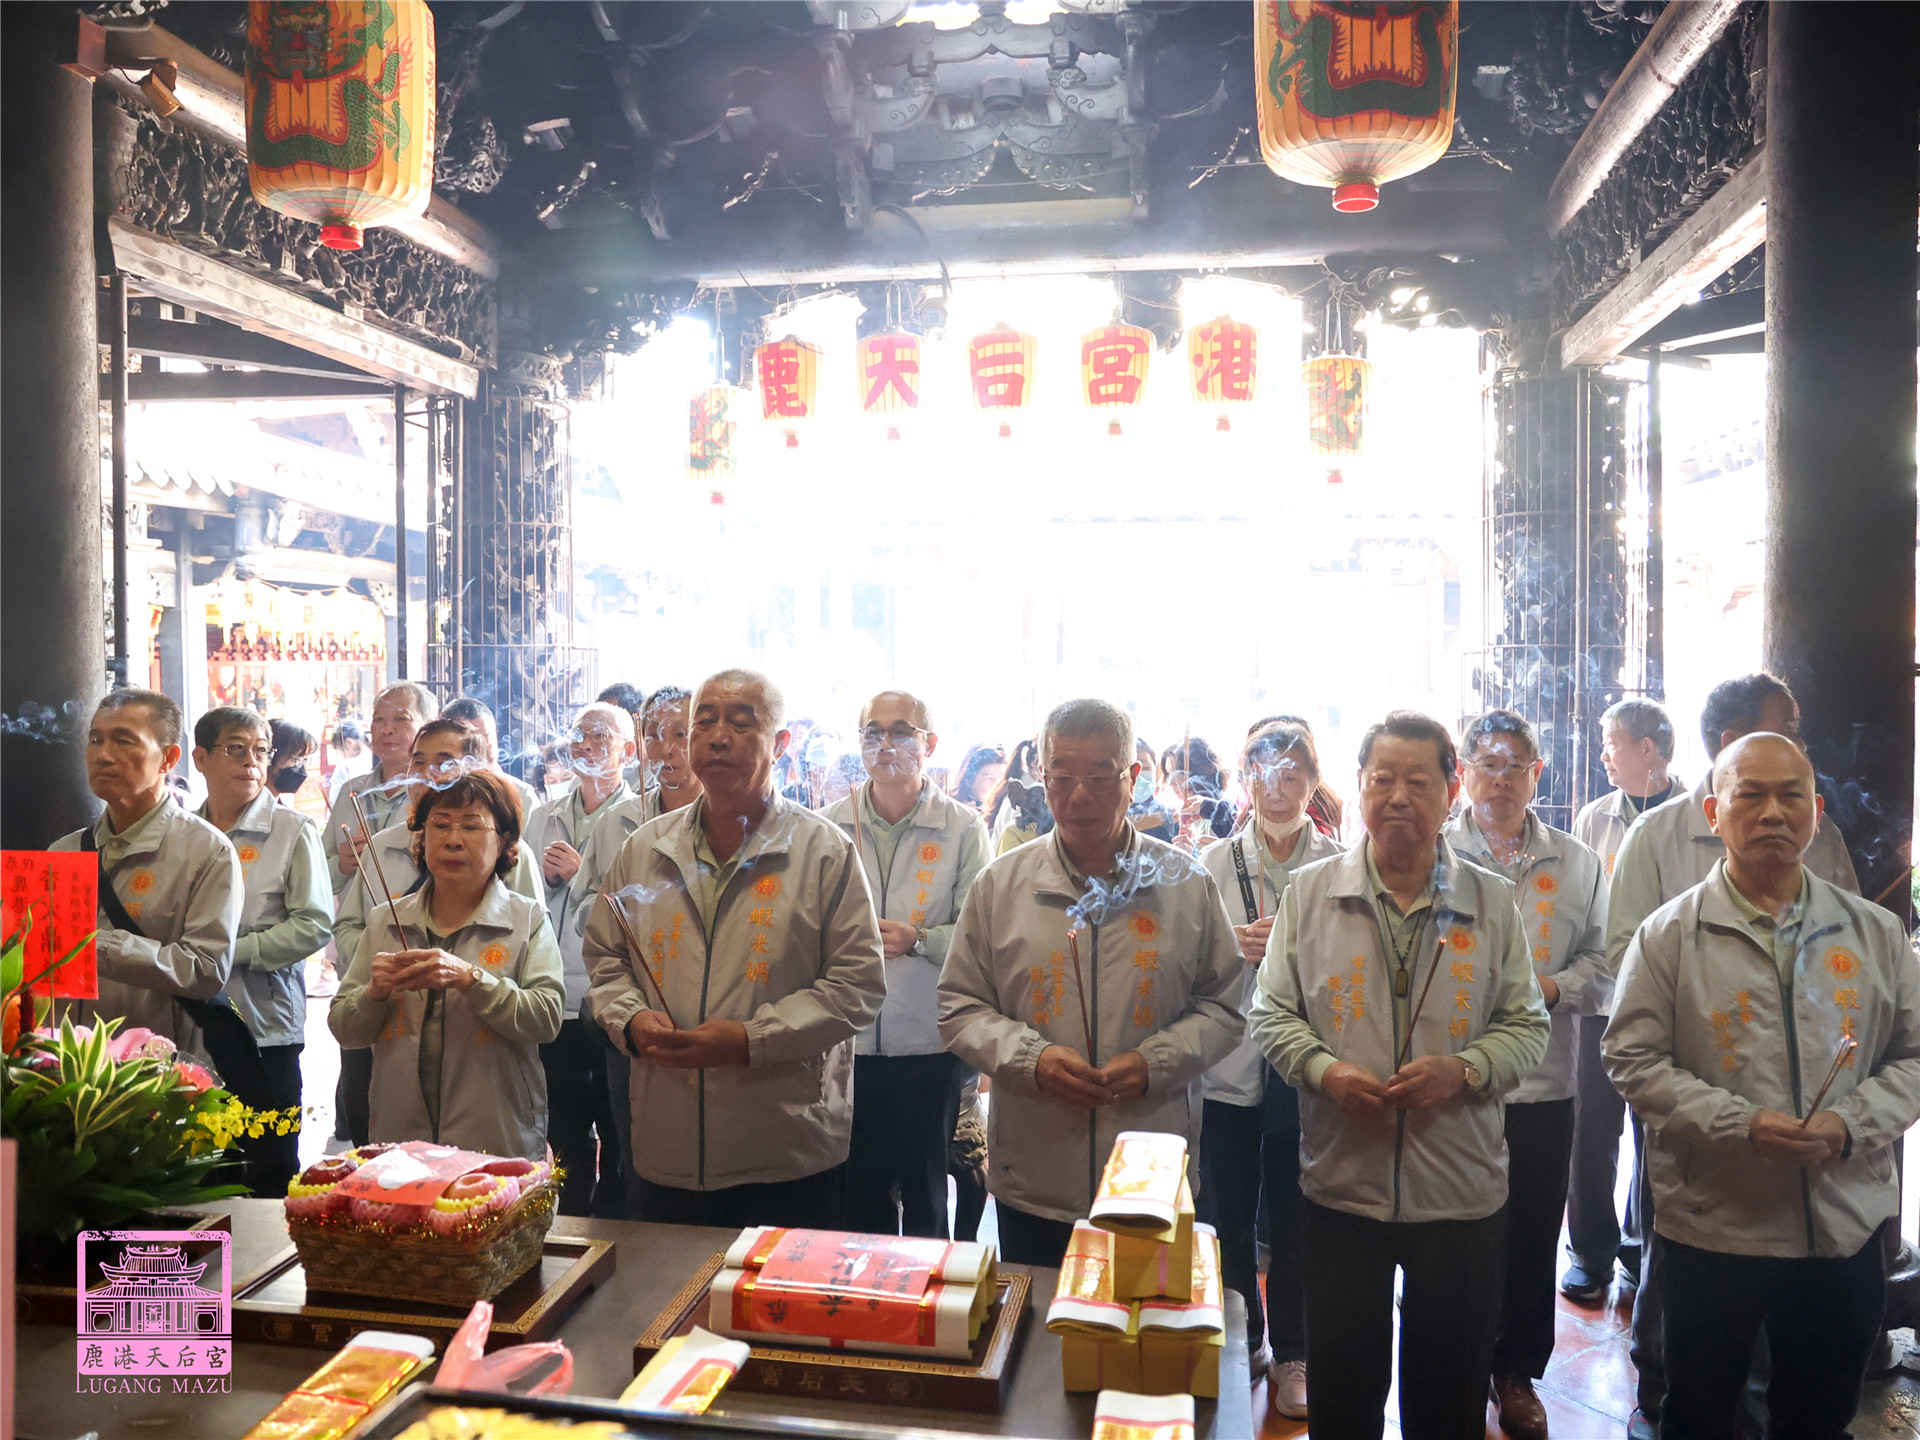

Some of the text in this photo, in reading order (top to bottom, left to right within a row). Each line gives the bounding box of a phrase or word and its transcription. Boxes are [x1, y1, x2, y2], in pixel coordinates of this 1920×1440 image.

[864, 336, 919, 411] 天
[969, 332, 1025, 409] 后
[1081, 327, 1150, 405] 宮
[1192, 322, 1258, 402] 港
